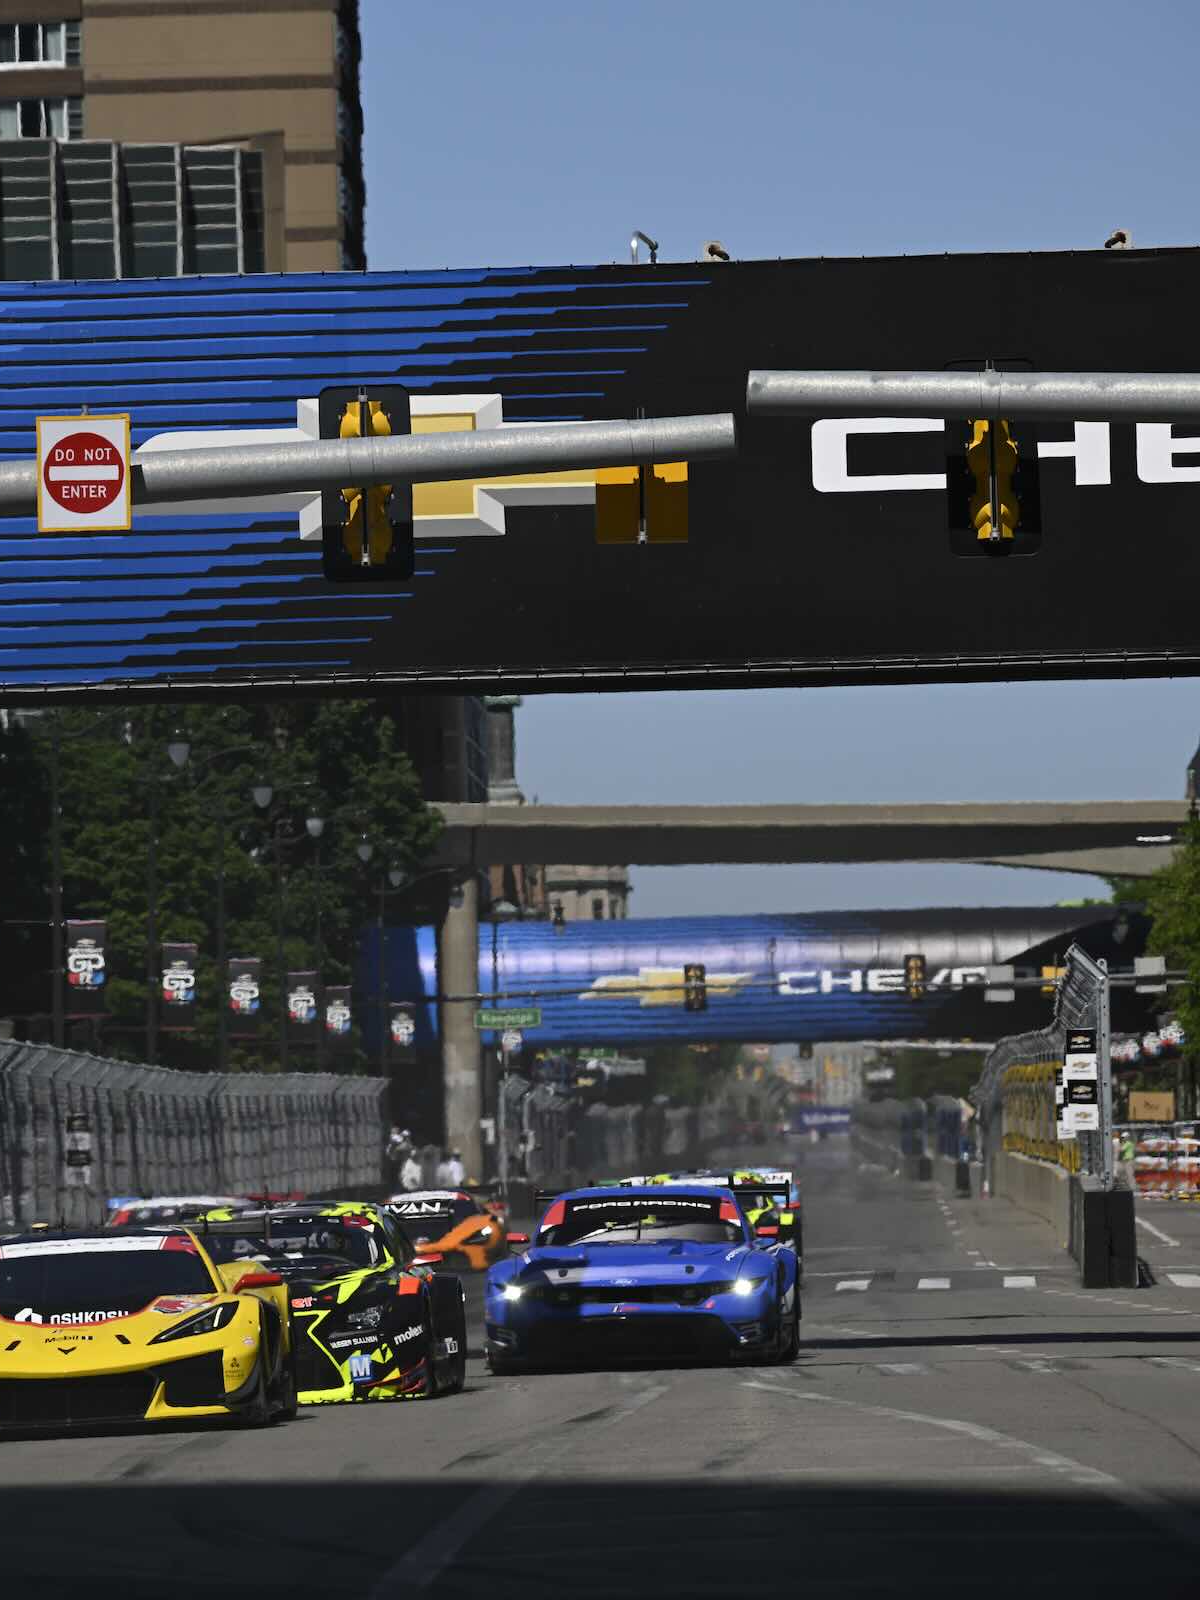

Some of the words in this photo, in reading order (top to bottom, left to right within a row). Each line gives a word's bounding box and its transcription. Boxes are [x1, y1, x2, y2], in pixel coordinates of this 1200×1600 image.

[55, 448, 75, 462] DO
[84, 447, 112, 462] NOT
[61, 484, 108, 499] ENTER
[68, 954, 106, 974] GP
[162, 974, 196, 992] GP
[573, 1200, 631, 1212] FORD
[633, 1200, 711, 1209] RACING
[393, 1324, 424, 1345] molex
